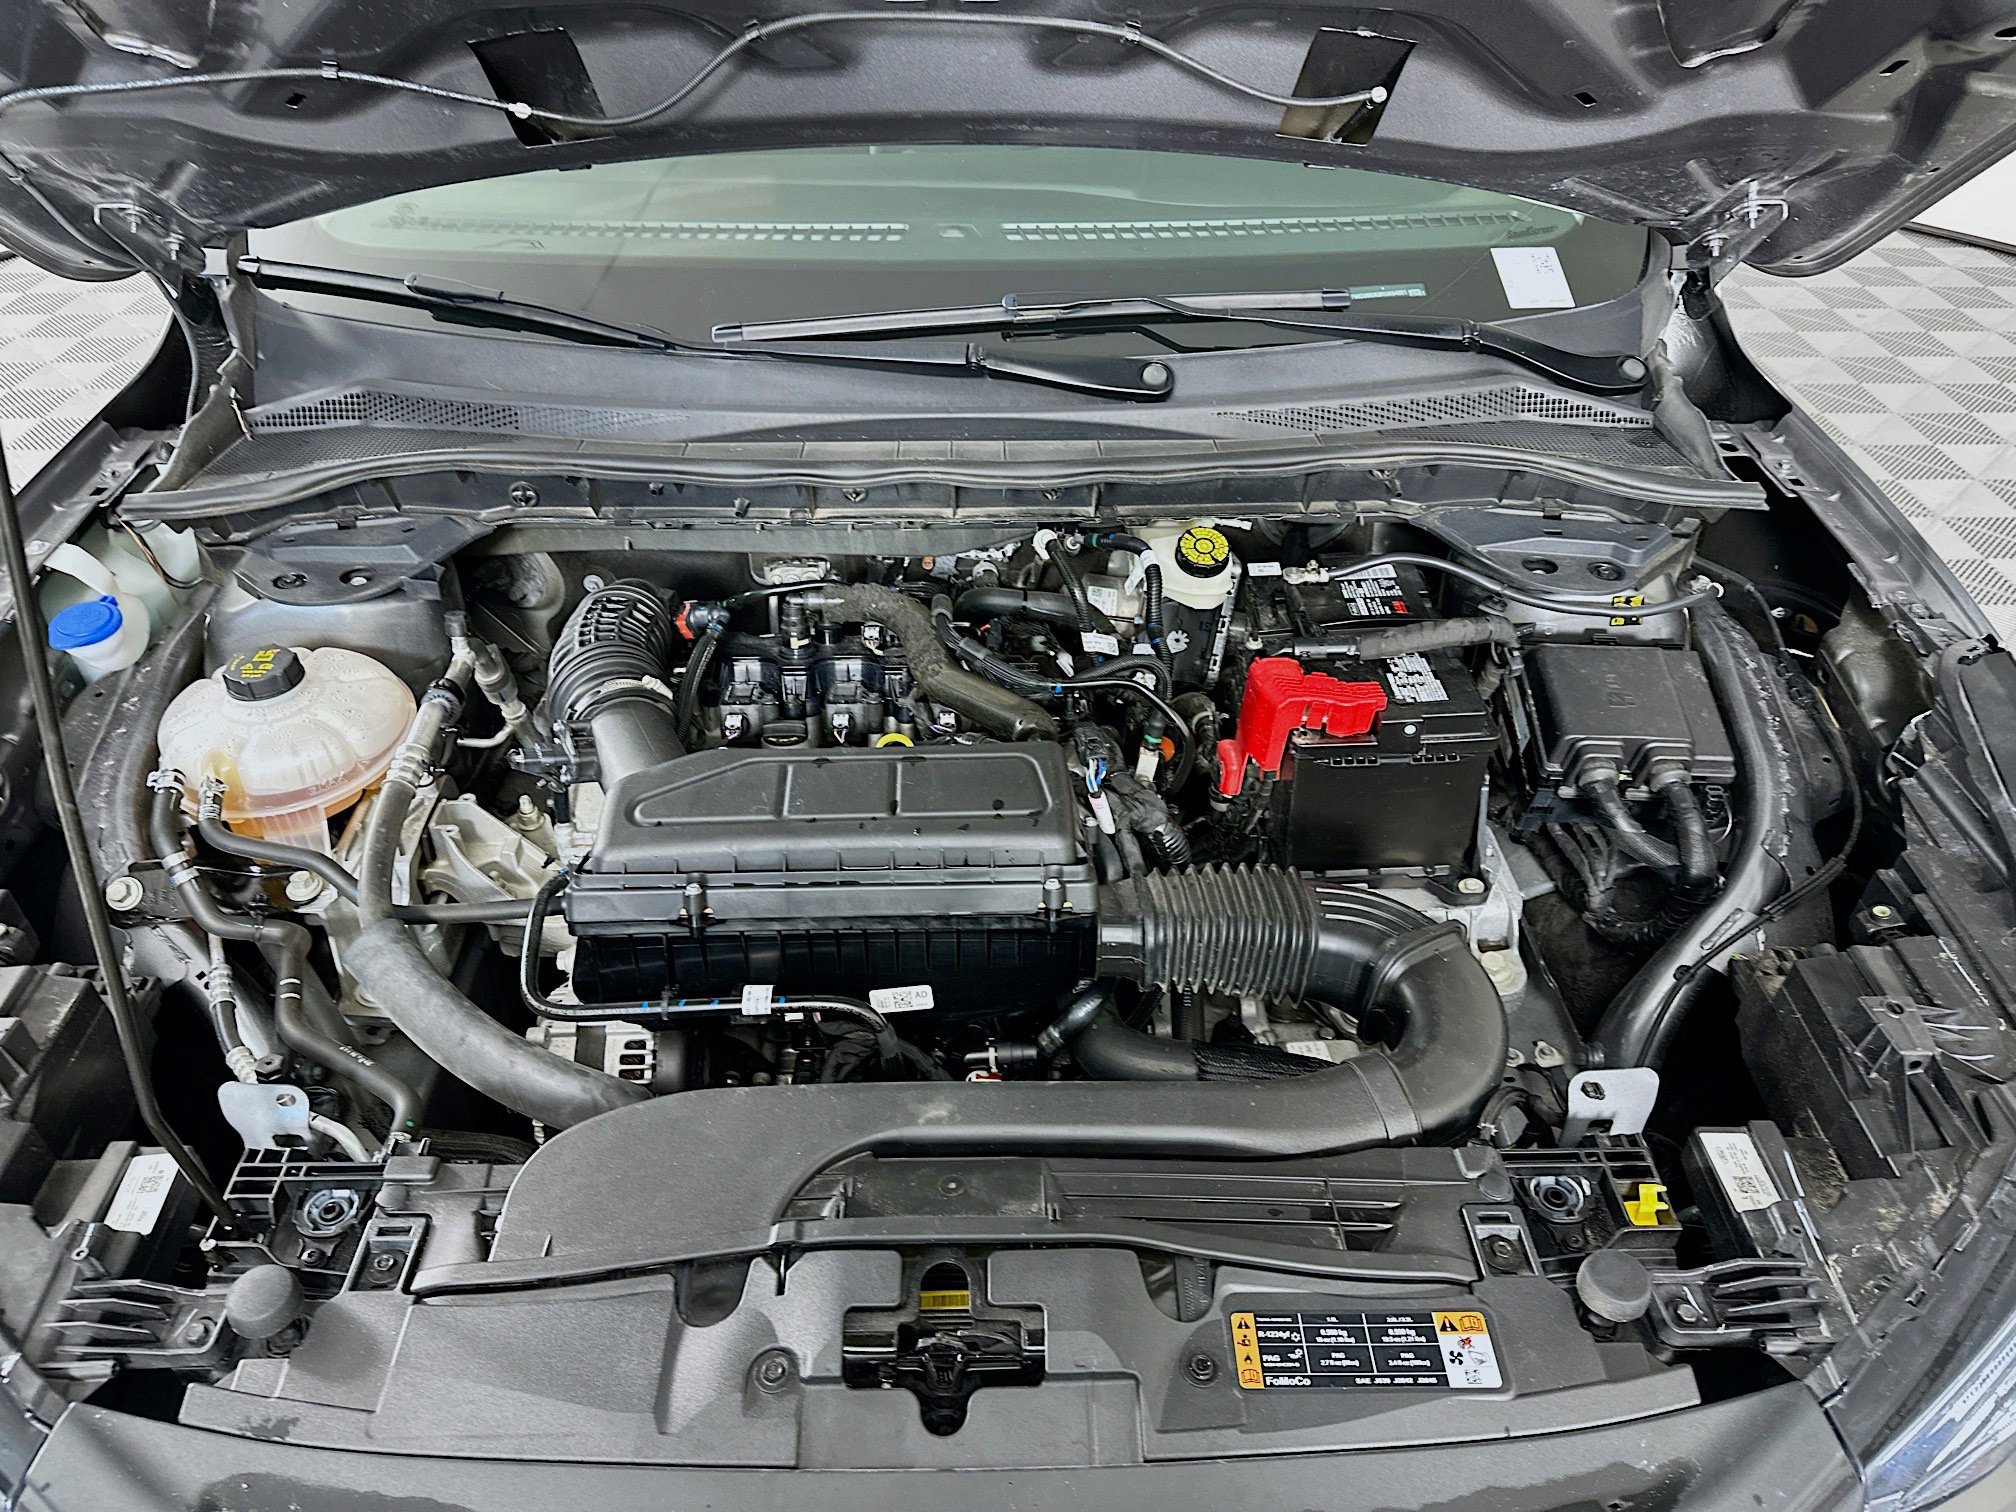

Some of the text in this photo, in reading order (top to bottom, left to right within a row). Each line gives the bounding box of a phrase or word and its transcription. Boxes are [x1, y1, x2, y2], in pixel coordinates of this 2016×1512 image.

[915, 990, 928, 998] AD
[1262, 1354, 1281, 1362] PAG
[1265, 1376, 1312, 1386] FoMoCo
